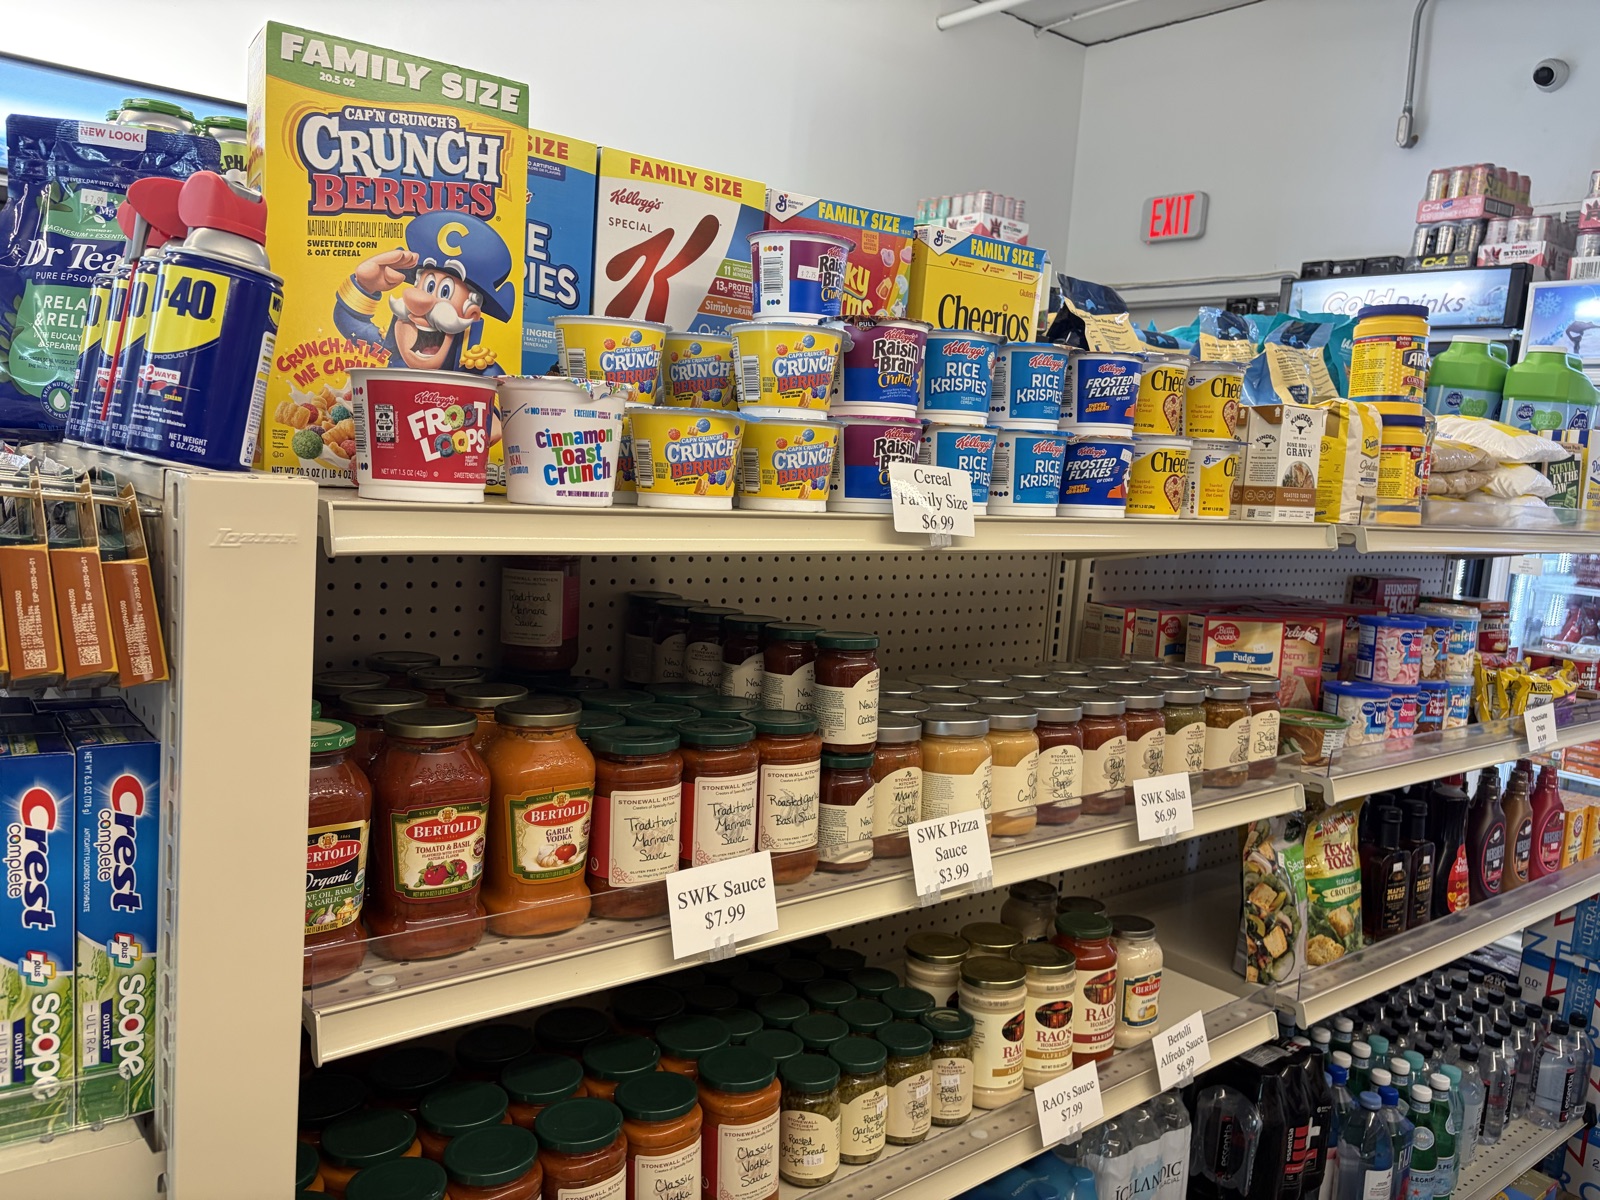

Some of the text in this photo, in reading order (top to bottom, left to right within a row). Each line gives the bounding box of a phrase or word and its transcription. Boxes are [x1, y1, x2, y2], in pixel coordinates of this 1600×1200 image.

[280, 31, 521, 113] FAMILY SIZE
[319, 71, 356, 88] 20.5 OZ
[344, 107, 458, 129] CAP'N CRUNCH'S
[80, 126, 144, 143] NEW LOOK!
[302, 115, 503, 185] CRUNCH
[630, 158, 743, 199] FAMILY SIZE
[313, 173, 493, 216] BERRIES
[609, 188, 663, 214] Kellogg's
[608, 216, 653, 234] SPECIAL
[818, 201, 901, 234] FAMILY SIZE
[1149, 193, 1196, 238] EXIT
[307, 219, 337, 236] NATURALLY
[343, 221, 377, 238] ARTIFICIALLY
[377, 223, 404, 239] FLAVORED
[307, 240, 378, 249] SWEETENED CORN
[314, 248, 329, 257] OAT
[330, 248, 361, 257] CEREAL
[970, 238, 1035, 268] FAMILY SIZE
[22, 240, 122, 275] Dr Tea
[1421, 256, 1448, 268] C4
[36, 271, 98, 284] PURE EPSOM
[1394, 291, 1465, 314] Drinks
[938, 293, 1030, 343] Cheerios
[883, 328, 919, 342] Kellogg's
[153, 351, 189, 361] PRODUCT
[873, 339, 918, 361] Raisin
[942, 340, 986, 359] Kellogg's
[774, 354, 835, 376] CRUNCH
[878, 357, 914, 375] Bran
[946, 362, 979, 378] RICE
[1028, 354, 1065, 373] Kellogg's
[1098, 363, 1127, 375] Kellogg's
[778, 371, 833, 391] BERRIES
[877, 373, 913, 388] Crunch
[930, 377, 987, 397] KRISPIES
[1032, 373, 1059, 389] RICE
[1085, 375, 1134, 390] FROSTED
[414, 391, 456, 408] Kellogg's
[1016, 388, 1063, 405] KRISPIES
[1088, 385, 1129, 399] FLAKES
[407, 401, 487, 441] FROOT
[169, 432, 208, 447] NET WEIGHT
[419, 428, 487, 463] LOOPS
[535, 428, 613, 449] Cinnamon
[551, 443, 603, 466] Toast
[666, 438, 735, 461] CRUNCH
[1286, 447, 1313, 458] GRAVY
[543, 457, 612, 486] Crunch
[671, 458, 732, 479] BERRIES
[1034, 459, 1060, 476] RICE
[1550, 460, 1576, 475] STEVIA
[1553, 469, 1579, 482] IN THE
[914, 468, 952, 487] Cereal
[945, 493, 968, 511] Size
[922, 513, 954, 530] $699
[1384, 583, 1418, 596] HUNGRY
[1232, 652, 1256, 663] Fudge
[1531, 712, 1548, 723] Chocolate
[1536, 724, 1546, 732] Chips
[1052, 765, 1075, 777] Ghost
[894, 789, 919, 802] Mango
[1051, 788, 1073, 800] Salsa
[1141, 788, 1186, 807] SWK Salsa
[530, 803, 588, 823] BERTOLLI
[707, 797, 755, 817] Traditional
[1154, 807, 1177, 823] $6.99
[624, 812, 678, 832] Traditional
[715, 817, 752, 833] Marinara
[774, 811, 816, 827] Basil Sauce
[897, 815, 918, 828] Salsa
[413, 819, 478, 839] BERTOLLI
[545, 826, 574, 837] GARLIC
[545, 833, 573, 843] VODKA
[916, 817, 980, 844] SWK Pizza
[95, 809, 112, 882] complete
[111, 773, 146, 913] Crest
[415, 845, 445, 855] TOMATO
[452, 840, 471, 850] BASIL
[632, 832, 675, 848] Marinara
[721, 834, 749, 846] Sauce
[7, 823, 22, 898] complete
[21, 788, 57, 930] Crest
[638, 850, 672, 863] Sauce
[934, 842, 968, 862] Sauce
[83, 857, 91, 880] FLUORIDE
[938, 862, 969, 885] $3.99
[335, 886, 353, 896] BASIL
[1387, 885, 1405, 895] MAPLE
[1416, 877, 1431, 886] MAPLE
[314, 896, 342, 907] GARLIC
[676, 875, 767, 911] SWK Sauce
[704, 903, 746, 930] $7.99
[1582, 905, 1598, 945] ULTRA
[120, 941, 129, 959] plus
[86, 1013, 96, 1054] ULTRA
[102, 1013, 111, 1050] OUTLAST
[111, 974, 146, 1078] scope
[1035, 1027, 1073, 1042] RAO'S
[1167, 1022, 1192, 1047] Bertolli
[15, 1032, 24, 1070] OUTLAST
[23, 993, 61, 1100] scope
[1041, 1051, 1069, 1060] ALFREDO
[1159, 1034, 1205, 1069] Alfredo Sauce
[1176, 1056, 1195, 1076] $6.99
[938, 1092, 963, 1103] Pesto
[940, 1084, 960, 1095] Basil
[1042, 1079, 1095, 1113] RAO's Sauce
[1564, 1074, 1575, 1110] essentia
[910, 1099, 929, 1112] Basil
[1060, 1103, 1084, 1122] $7.99
[911, 1108, 930, 1123] Pesto
[788, 1134, 816, 1147] Roasted
[1221, 1123, 1233, 1168] essentia
[1286, 1127, 1295, 1162] essentia
[736, 1141, 774, 1161] Classic
[739, 1158, 772, 1174] Vodka
[654, 1173, 695, 1193] Classic
[740, 1171, 772, 1188] Sauce
